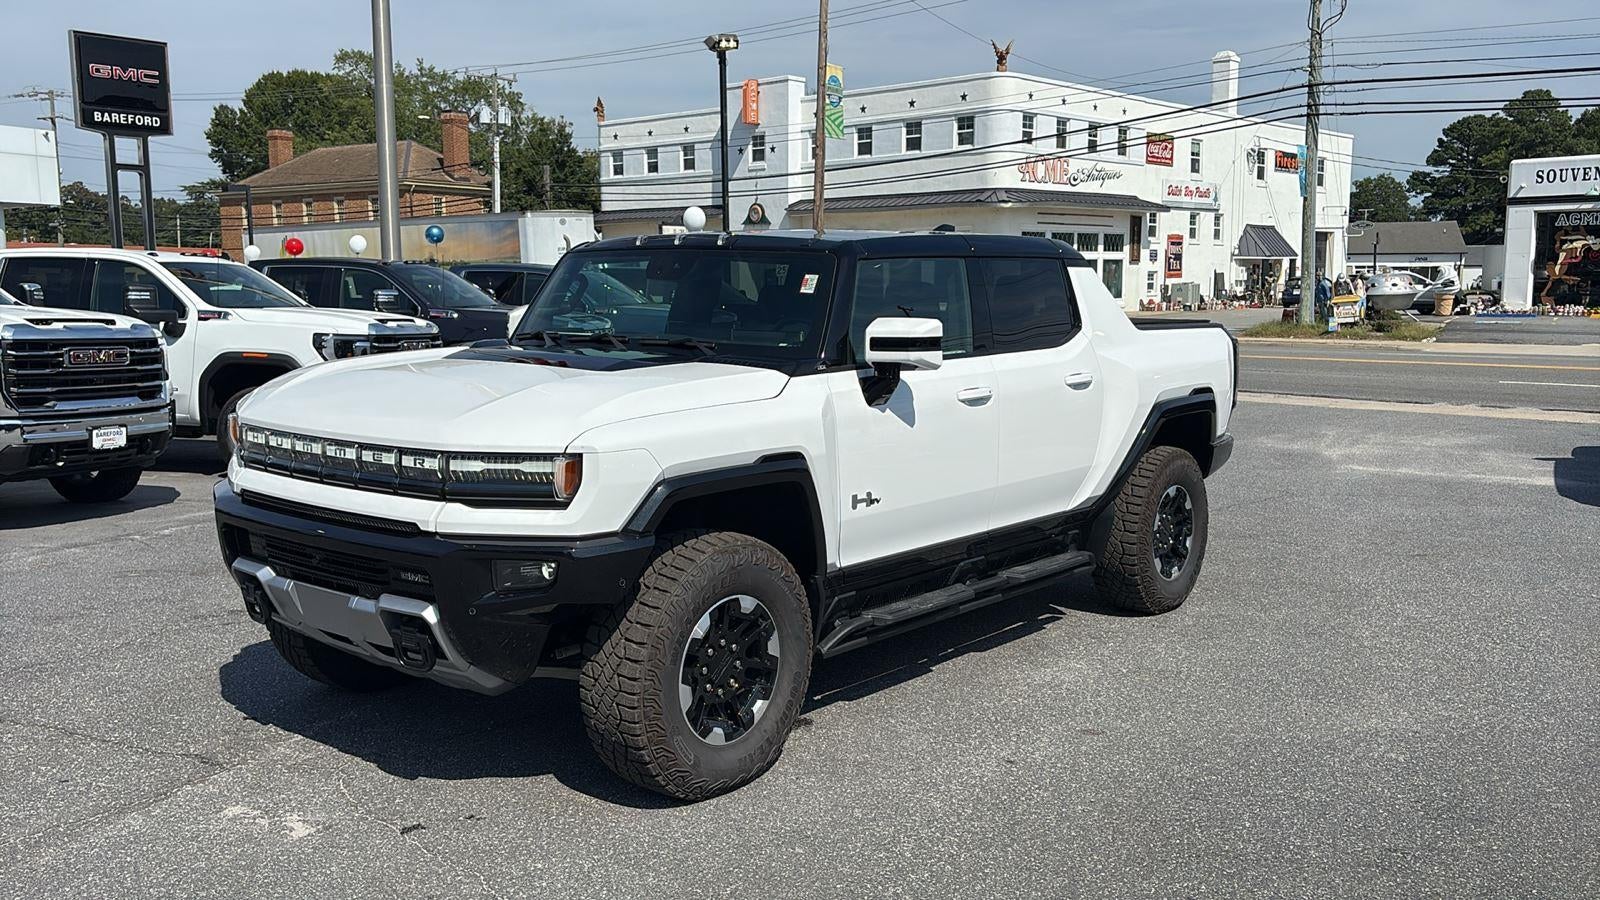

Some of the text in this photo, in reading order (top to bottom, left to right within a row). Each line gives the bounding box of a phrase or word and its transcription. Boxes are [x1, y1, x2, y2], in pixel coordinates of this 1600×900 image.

[89, 63, 160, 84] GMC
[93, 111, 161, 127] BAREFORD
[1018, 155, 1123, 188] ACME Antiques
[1167, 184, 1211, 200] Dutch Boy Paints
[1169, 259, 1181, 270] TEA
[70, 349, 128, 364] GMC
[95, 430, 124, 438] BAREFORD
[252, 433, 426, 468] HUMMER
